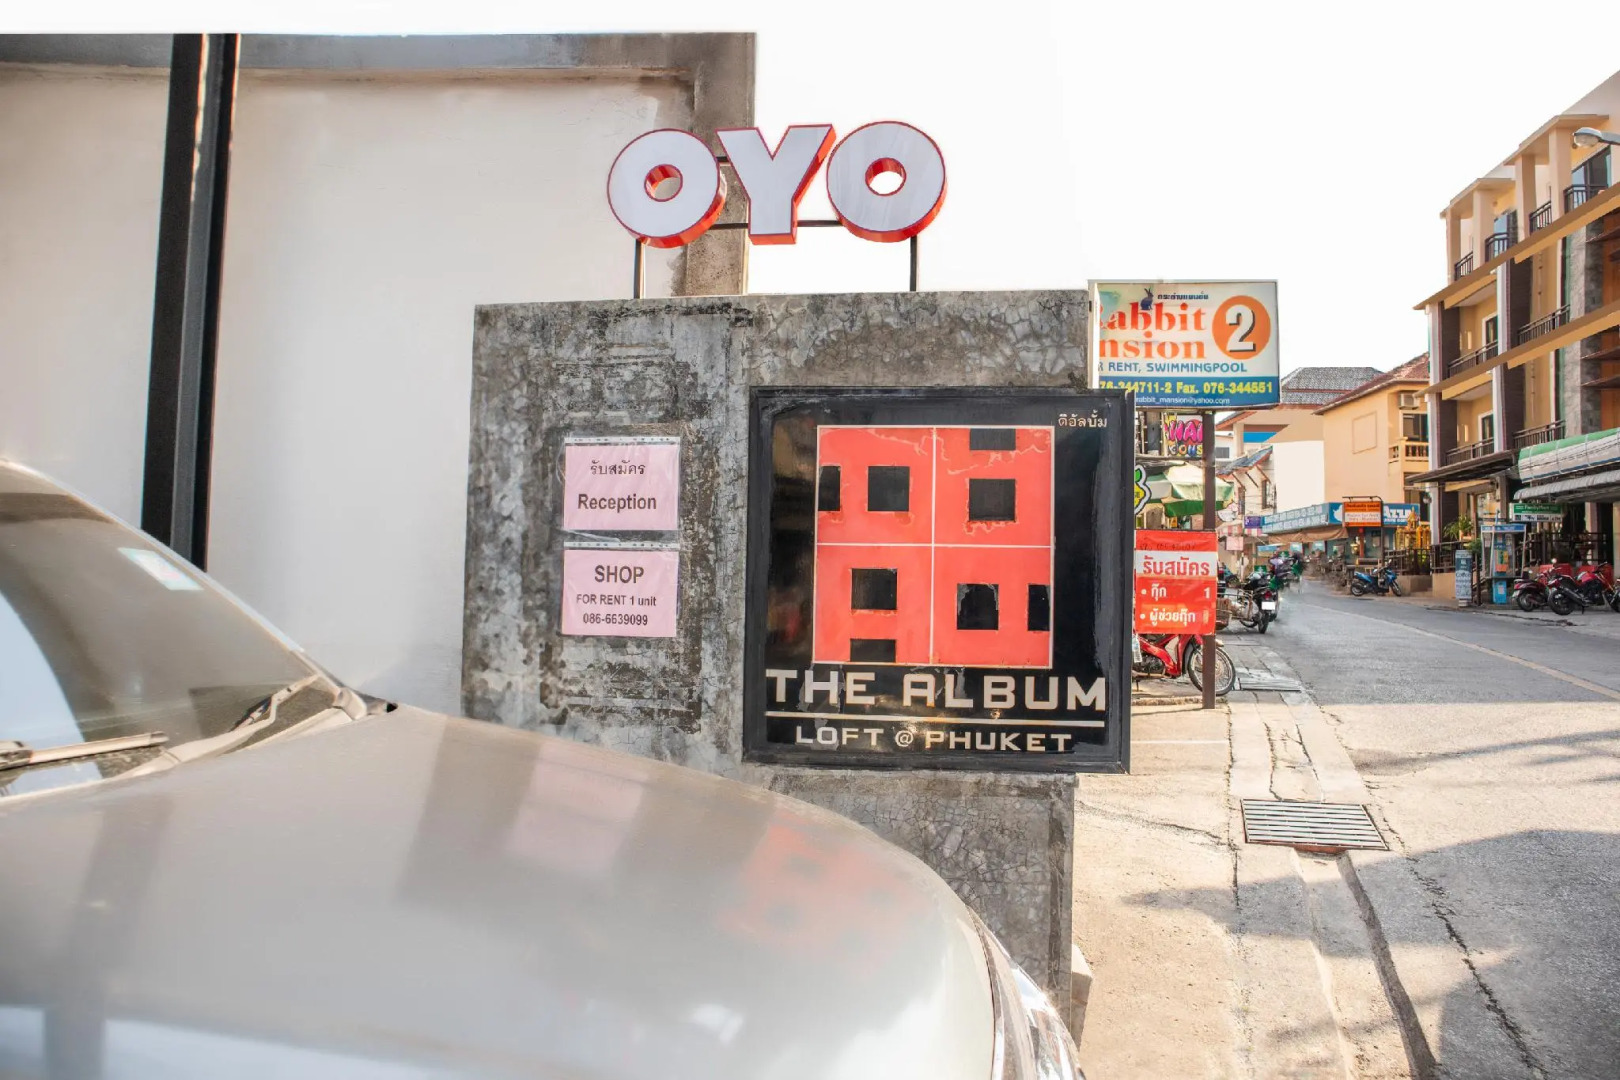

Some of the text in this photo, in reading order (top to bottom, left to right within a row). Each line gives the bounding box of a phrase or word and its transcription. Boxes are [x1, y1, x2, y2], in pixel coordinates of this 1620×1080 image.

[607, 121, 947, 248] OYO
[1225, 304, 1257, 353] 2
[1108, 361, 1141, 374] RENT,
[1147, 362, 1247, 373] SWIMMINGPOOL
[1176, 381, 1199, 394] Fax.
[590, 460, 646, 476] รับสมัคร
[578, 493, 657, 513] Reception
[594, 564, 645, 584] SHOP
[1143, 555, 1210, 576] รับสมัคร
[576, 594, 657, 607] FOR RENT 1 unit
[1204, 587, 1211, 599] 1
[583, 612, 648, 626] 086-6639099
[765, 668, 1106, 711] THE ALBUM
[795, 726, 1072, 753] LOFT @ PHUKET
